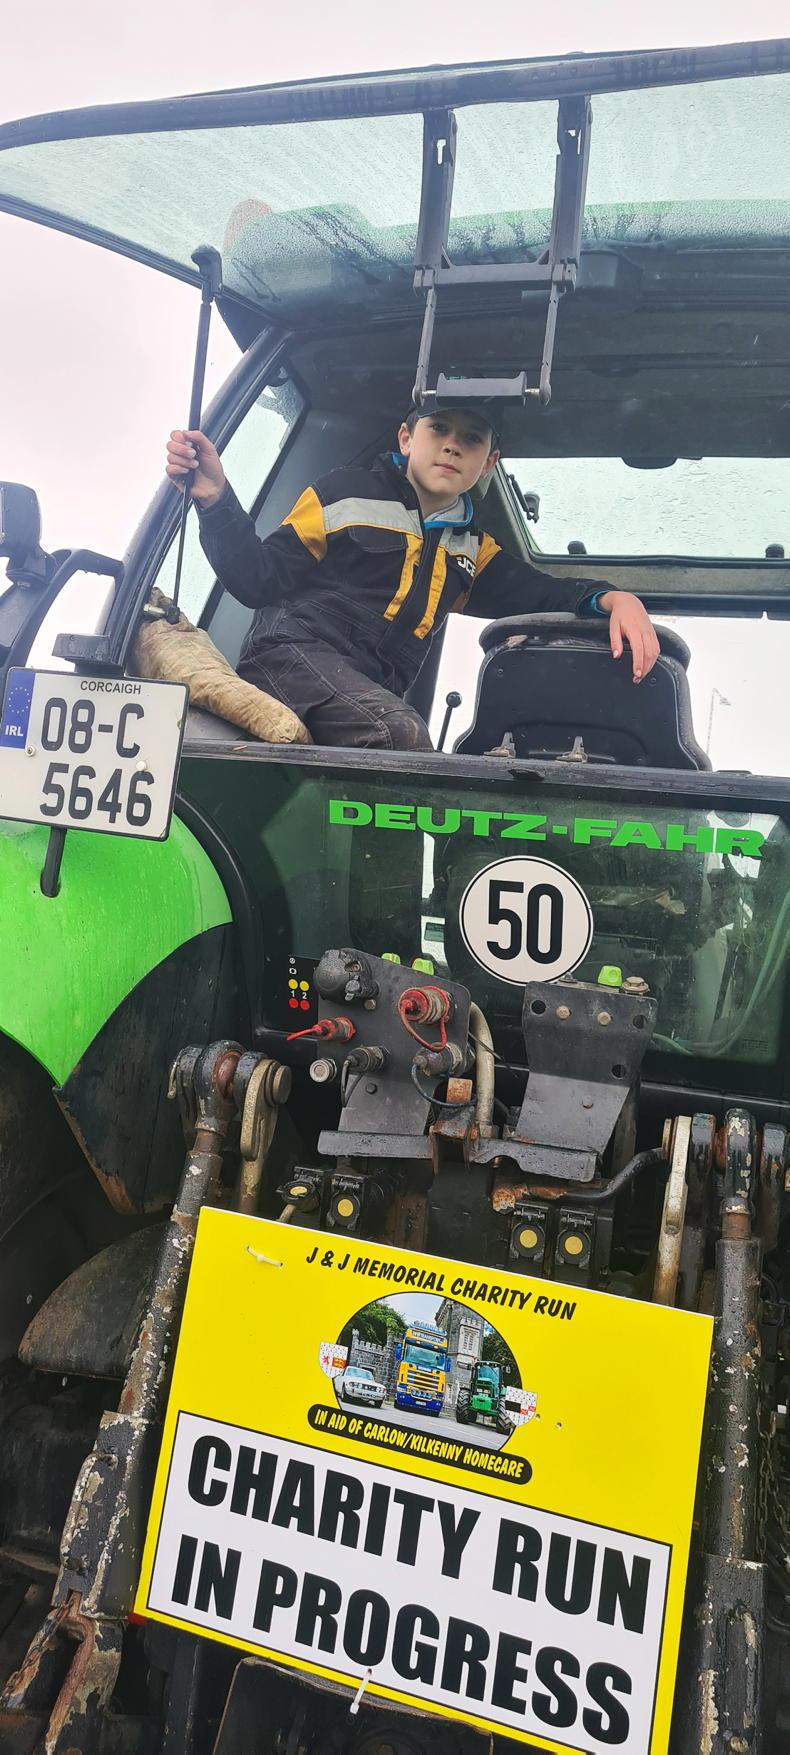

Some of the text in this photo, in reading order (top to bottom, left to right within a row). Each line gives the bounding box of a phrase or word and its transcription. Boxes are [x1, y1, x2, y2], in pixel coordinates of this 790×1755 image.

[80, 680, 141, 695] CORCAIGH
[5, 725, 24, 737] IRL
[41, 697, 144, 758] 08-C
[39, 762, 155, 827] 5646
[329, 800, 766, 857] DEUTZ-FAHR
[487, 880, 564, 965] 50
[306, 1247, 577, 1321] J & J MEMORIAL CHARITY RUN
[314, 1409, 525, 1479] IN AID OF CARLOW/KILKENNY HOMECARE
[187, 1435, 652, 1634] CHARITY RUN
[171, 1534, 633, 1745] IN PROGRESS
